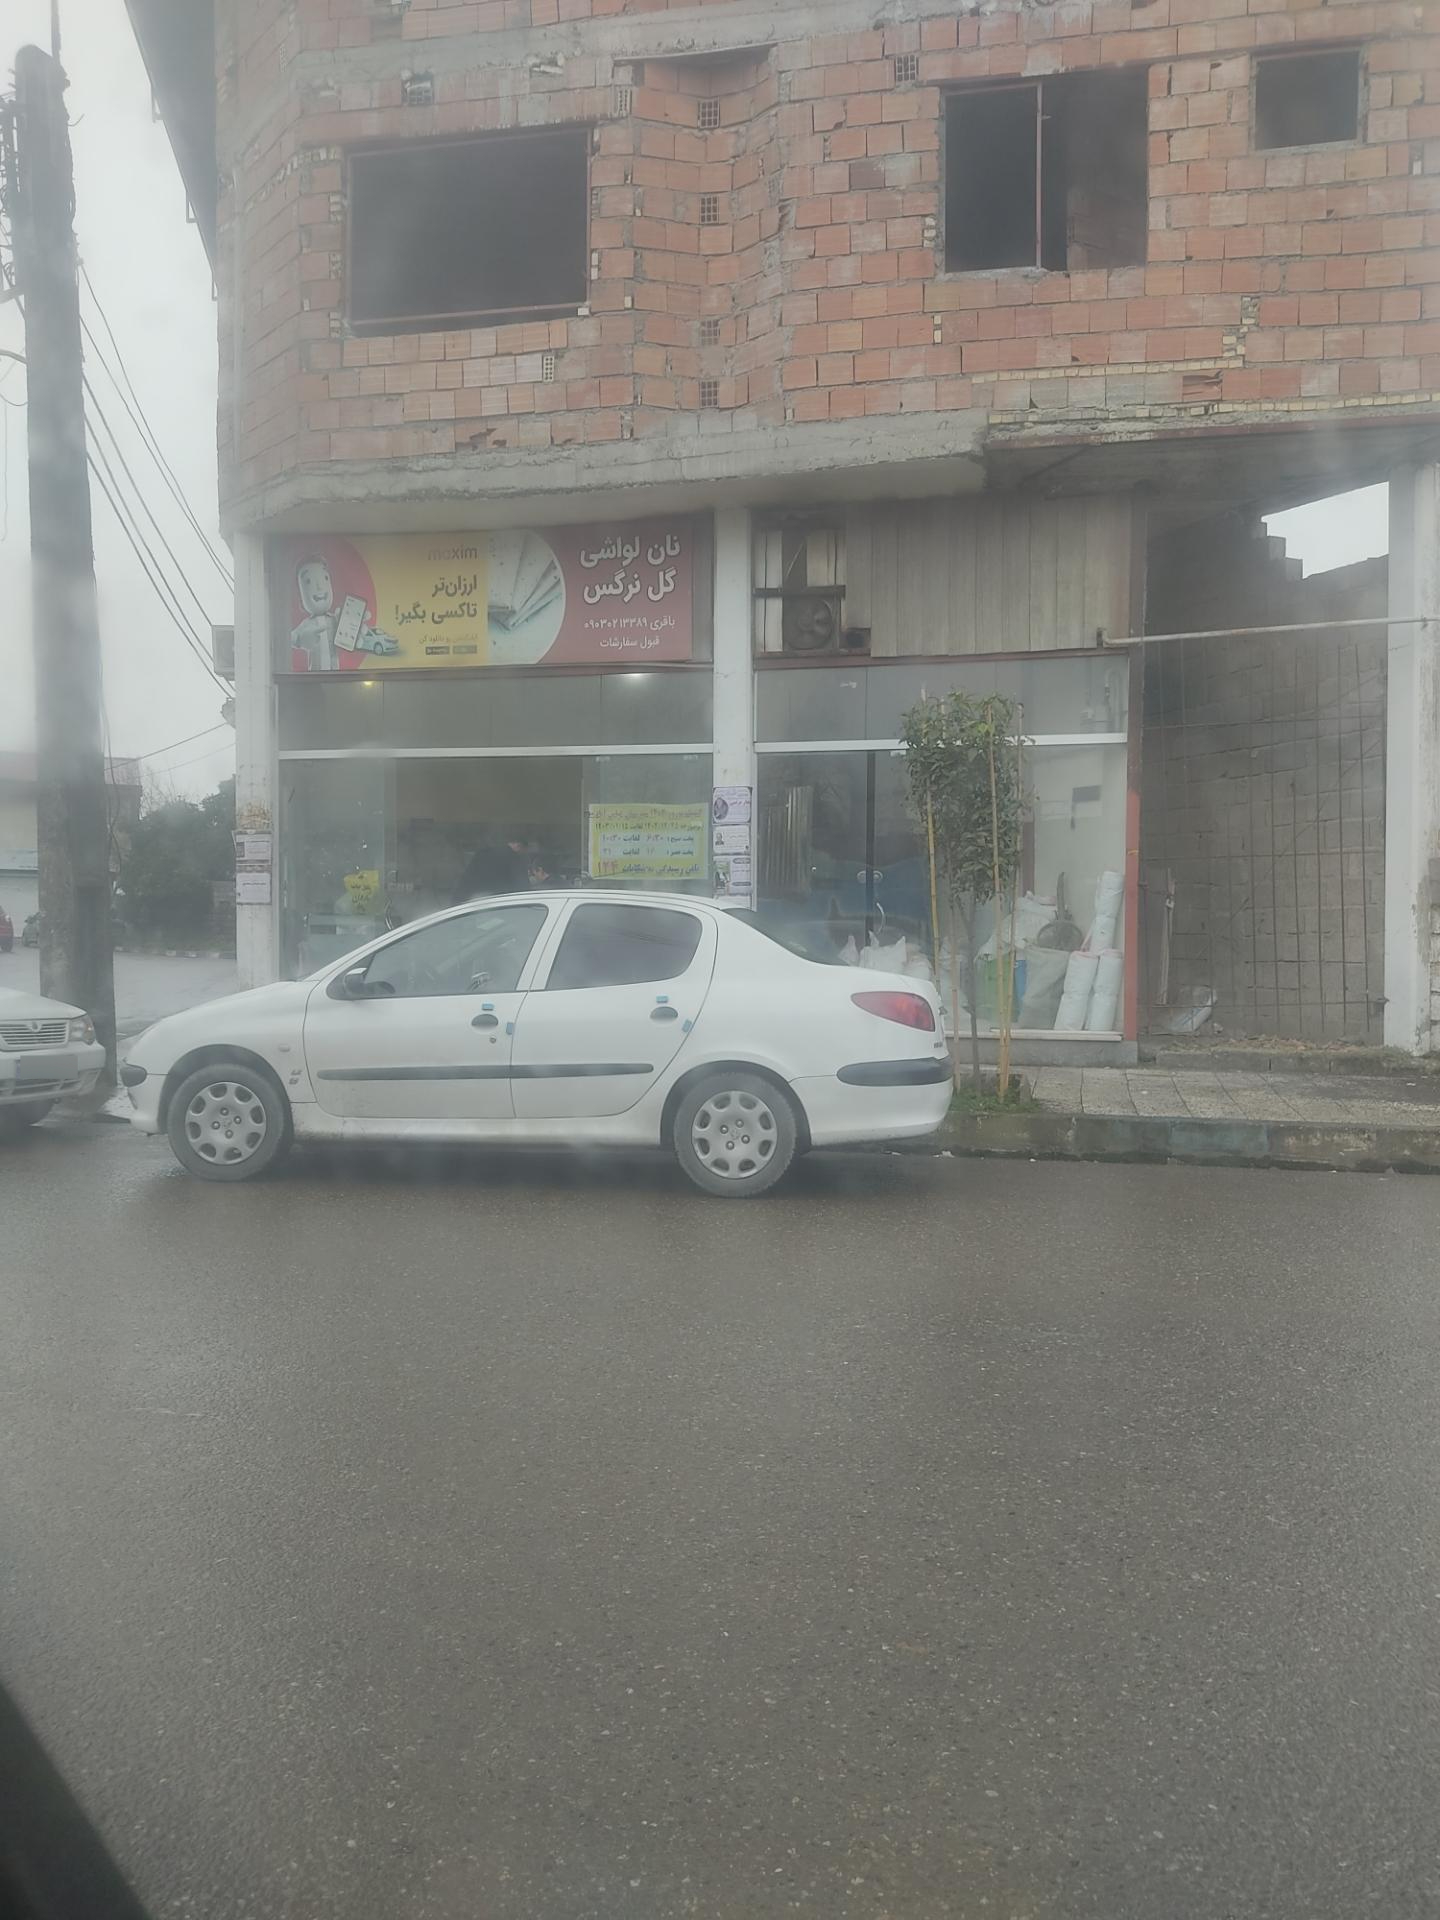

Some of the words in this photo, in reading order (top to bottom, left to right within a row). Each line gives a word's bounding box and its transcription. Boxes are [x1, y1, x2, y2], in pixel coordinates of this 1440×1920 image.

[427, 544, 478, 560] maxim
[580, 535, 640, 568] لواشی
[647, 534, 681, 566] نان
[583, 568, 641, 604] نرگس
[647, 566, 677, 602] گل
[395, 600, 426, 626] بگیر!
[432, 601, 478, 625] تاکسی
[649, 615, 676, 631] باقری
[599, 635, 638, 650] سفارشات
[640, 635, 661, 649] قبول
